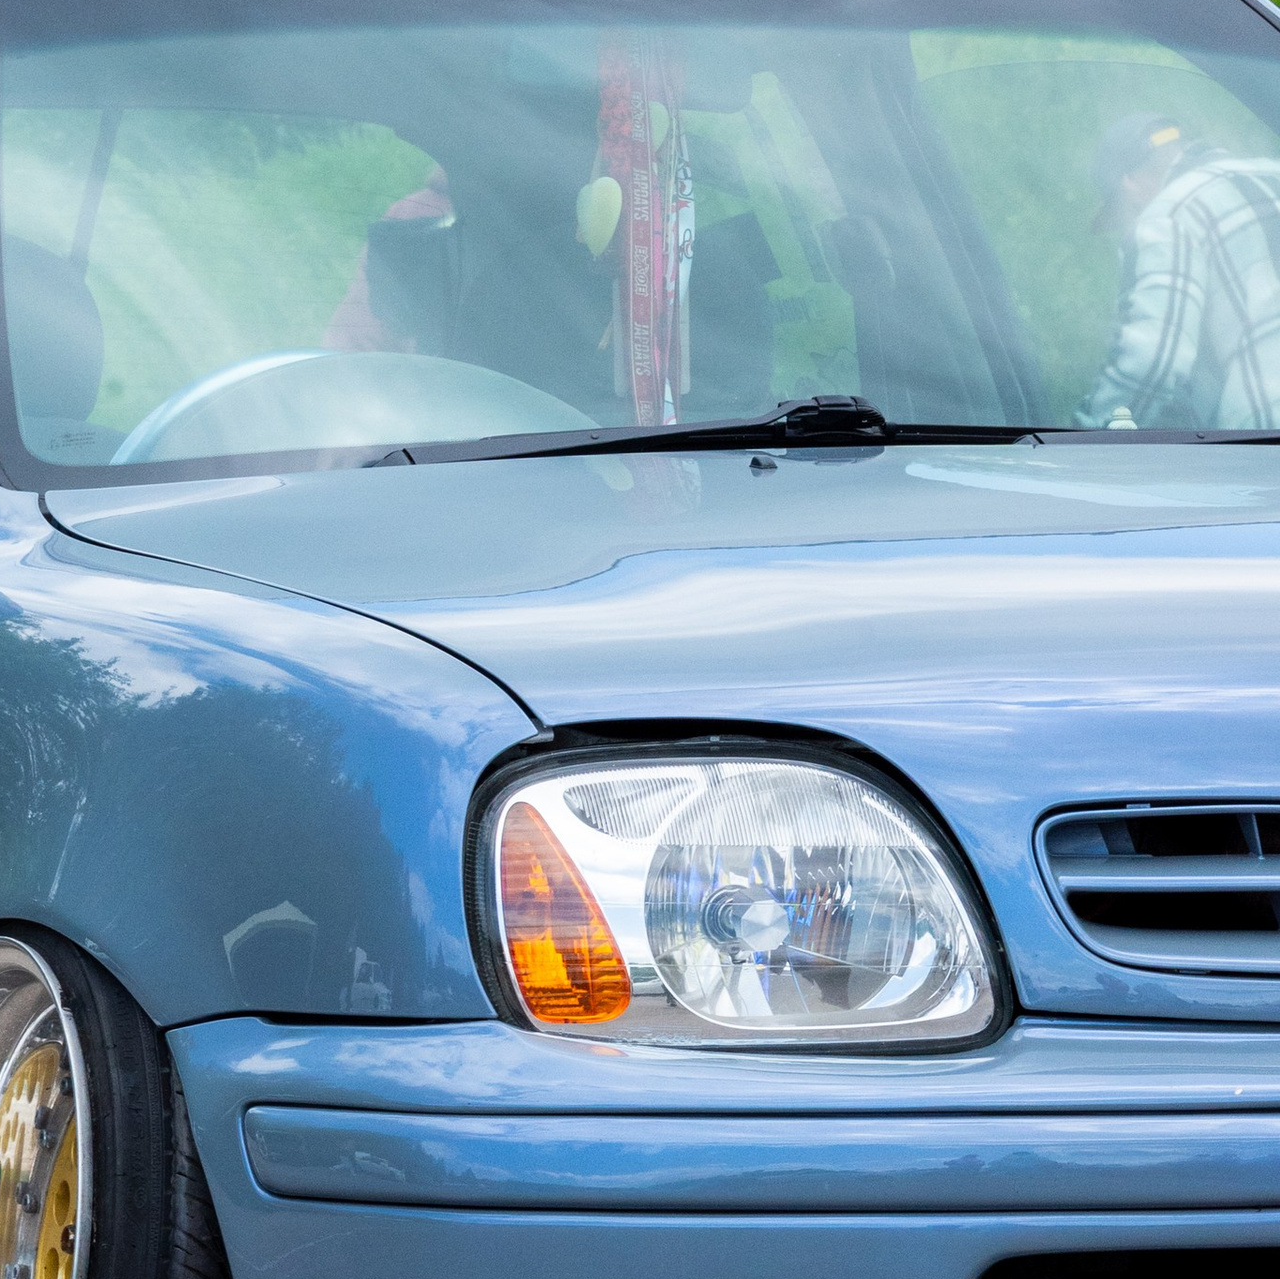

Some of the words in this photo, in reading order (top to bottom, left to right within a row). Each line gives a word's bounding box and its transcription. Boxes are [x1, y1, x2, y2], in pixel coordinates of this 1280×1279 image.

[633, 167, 650, 222] JAPDAYS
[634, 245, 650, 296] 日本の日
[633, 321, 651, 377] JAPDAYS
